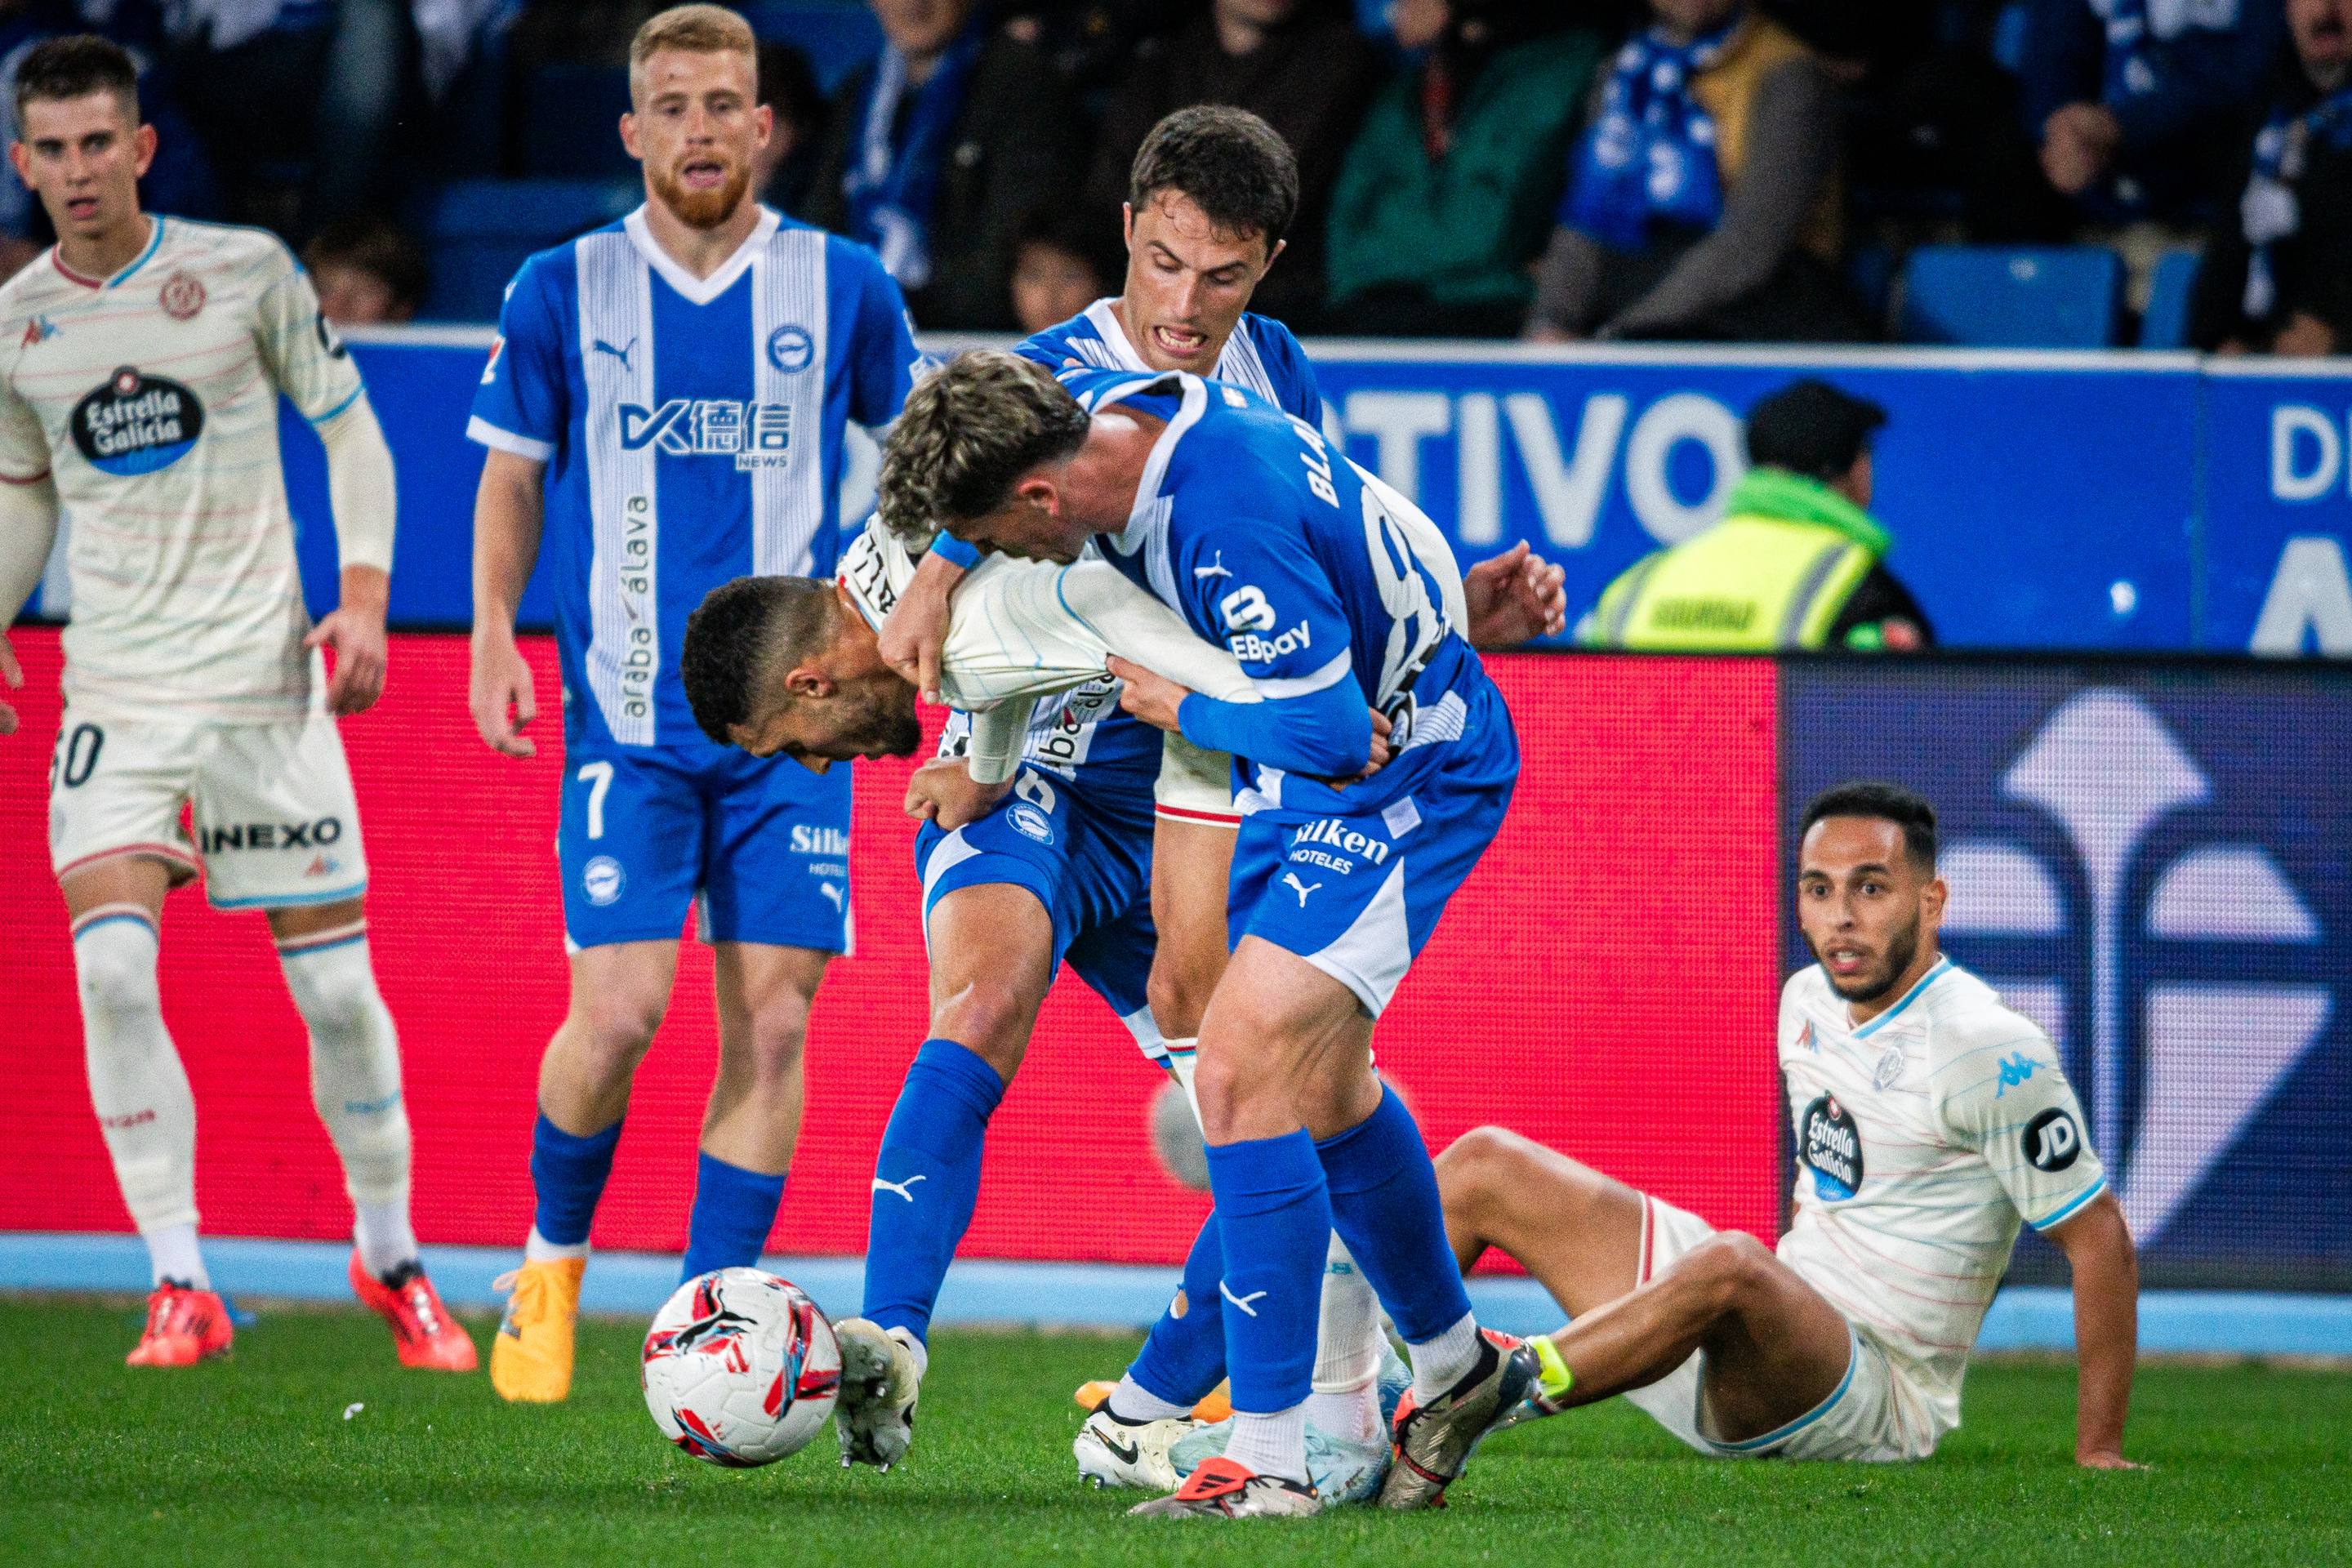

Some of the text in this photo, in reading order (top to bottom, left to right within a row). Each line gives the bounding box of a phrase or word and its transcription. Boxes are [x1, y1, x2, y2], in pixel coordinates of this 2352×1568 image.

[86, 390, 181, 432] Estrella
[94, 417, 182, 457] Galicia
[2272, 406, 2352, 500] D
[737, 455, 789, 469] NEWS
[1284, 412, 1341, 510] BLA
[1321, 389, 1749, 549] TIVO
[620, 495, 653, 719] araba álava
[1230, 619, 1311, 664] EBpay
[52, 723, 105, 789] 0
[577, 760, 614, 840] 7
[201, 816, 342, 855] INEXO
[789, 824, 849, 856] Silk
[1289, 849, 1353, 875] HOTELES
[1807, 1111, 1854, 1159] Estrella
[2034, 1116, 2074, 1166] JD
[1807, 1140, 1853, 1185] Galicia
